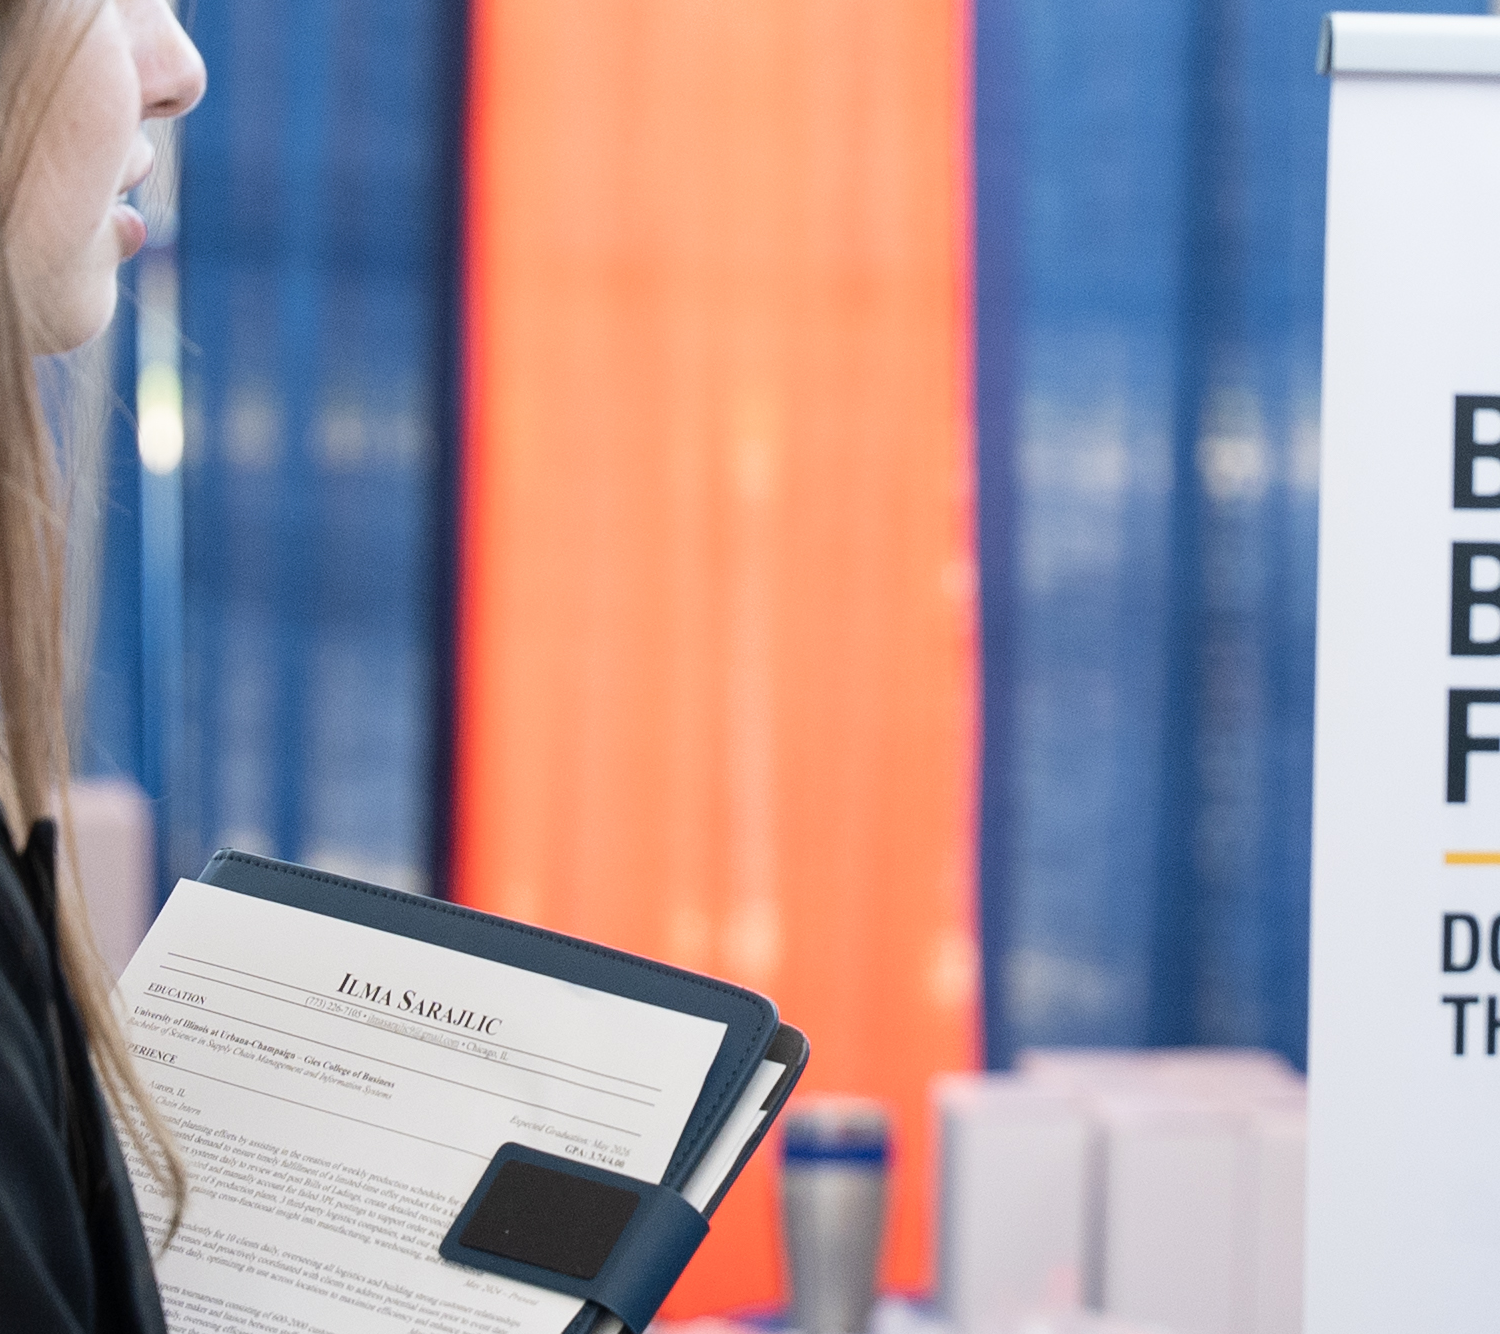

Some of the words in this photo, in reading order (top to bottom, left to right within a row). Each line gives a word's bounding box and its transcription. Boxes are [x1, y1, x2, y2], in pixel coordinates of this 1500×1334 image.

[147, 982, 206, 1005] EDUCATION
[336, 972, 395, 1006] ILMA
[396, 990, 500, 1035] SARAJLIC
[125, 1016, 160, 1031] Bachelor
[159, 1026, 171, 1035] of
[168, 1028, 197, 1043] Science
[196, 1037, 206, 1045] in
[205, 1039, 232, 1054] Supply
[231, 1047, 256, 1060] Chain
[254, 1054, 304, 1075] Management
[302, 1068, 320, 1078] and
[318, 1072, 362, 1091] Information
[361, 1084, 393, 1100] Systems
[132, 1006, 172, 1024] University
[172, 1017, 183, 1026] of
[181, 1019, 209, 1034] Illinois
[209, 1028, 220, 1037] at
[218, 1030, 296, 1060] Urbana-Champaign
[302, 1055, 322, 1067] Gies
[321, 1060, 352, 1077] College
[351, 1069, 363, 1078] of
[361, 1072, 396, 1088] Business
[147, 1080, 176, 1095] Aurora,
[176, 1087, 186, 1097] IL
[153, 1095, 178, 1108] Chain
[177, 1102, 202, 1115] Intern
[179, 1119, 213, 1136] planning
[213, 1129, 238, 1141] efforts
[247, 1139, 280, 1155] assisting
[289, 1149, 302, 1159] the
[301, 1154, 332, 1167] creation
[341, 1165, 368, 1179] weekly
[367, 1173, 409, 1190] production
[409, 1185, 446, 1201] schedules
[446, 1196, 460, 1206] for
[508, 1115, 545, 1133] Expected
[543, 1125, 589, 1145] Graduation:
[591, 1139, 610, 1152] May
[609, 1144, 631, 1157] 2026
[189, 1147, 219, 1161] systems
[218, 1155, 238, 1168] daily
[246, 1163, 272, 1175] review
[272, 1170, 288, 1179] and
[285, 1174, 304, 1185] post
[303, 1177, 322, 1189] Bills
[330, 1186, 363, 1202] Ladings,
[363, 1196, 388, 1208] create
[387, 1203, 419, 1218] detailed
[193, 1135, 224, 1149] demand
[231, 1147, 256, 1159] ensure
[255, 1153, 280, 1167] timely
[280, 1159, 319, 1176] fulfillment
[334, 1174, 380, 1193] limited-time
[379, 1188, 399, 1199] offer
[397, 1194, 429, 1209] product
[429, 1203, 442, 1212] for
[207, 1164, 223, 1174] and
[221, 1168, 255, 1184] manually
[255, 1178, 285, 1191] account
[284, 1185, 298, 1194] for
[296, 1188, 320, 1201] failed
[333, 1200, 367, 1216] postings
[376, 1213, 406, 1227] support
[405, 1222, 428, 1233] order
[189, 1184, 218, 1199] gaining
[217, 1192, 275, 1213] cross-functional
[274, 1208, 301, 1221] insight
[300, 1215, 316, 1225] into
[315, 1220, 372, 1243] manufacturing,
[373, 1238, 423, 1259] warehousing,
[424, 1253, 441, 1263] and
[213, 1179, 254, 1196] production
[252, 1189, 278, 1203] plants,
[285, 1198, 325, 1216] third-party
[324, 1209, 357, 1225] logistics
[356, 1220, 400, 1239] companies,
[400, 1233, 416, 1243] and
[415, 1239, 430, 1247] our
